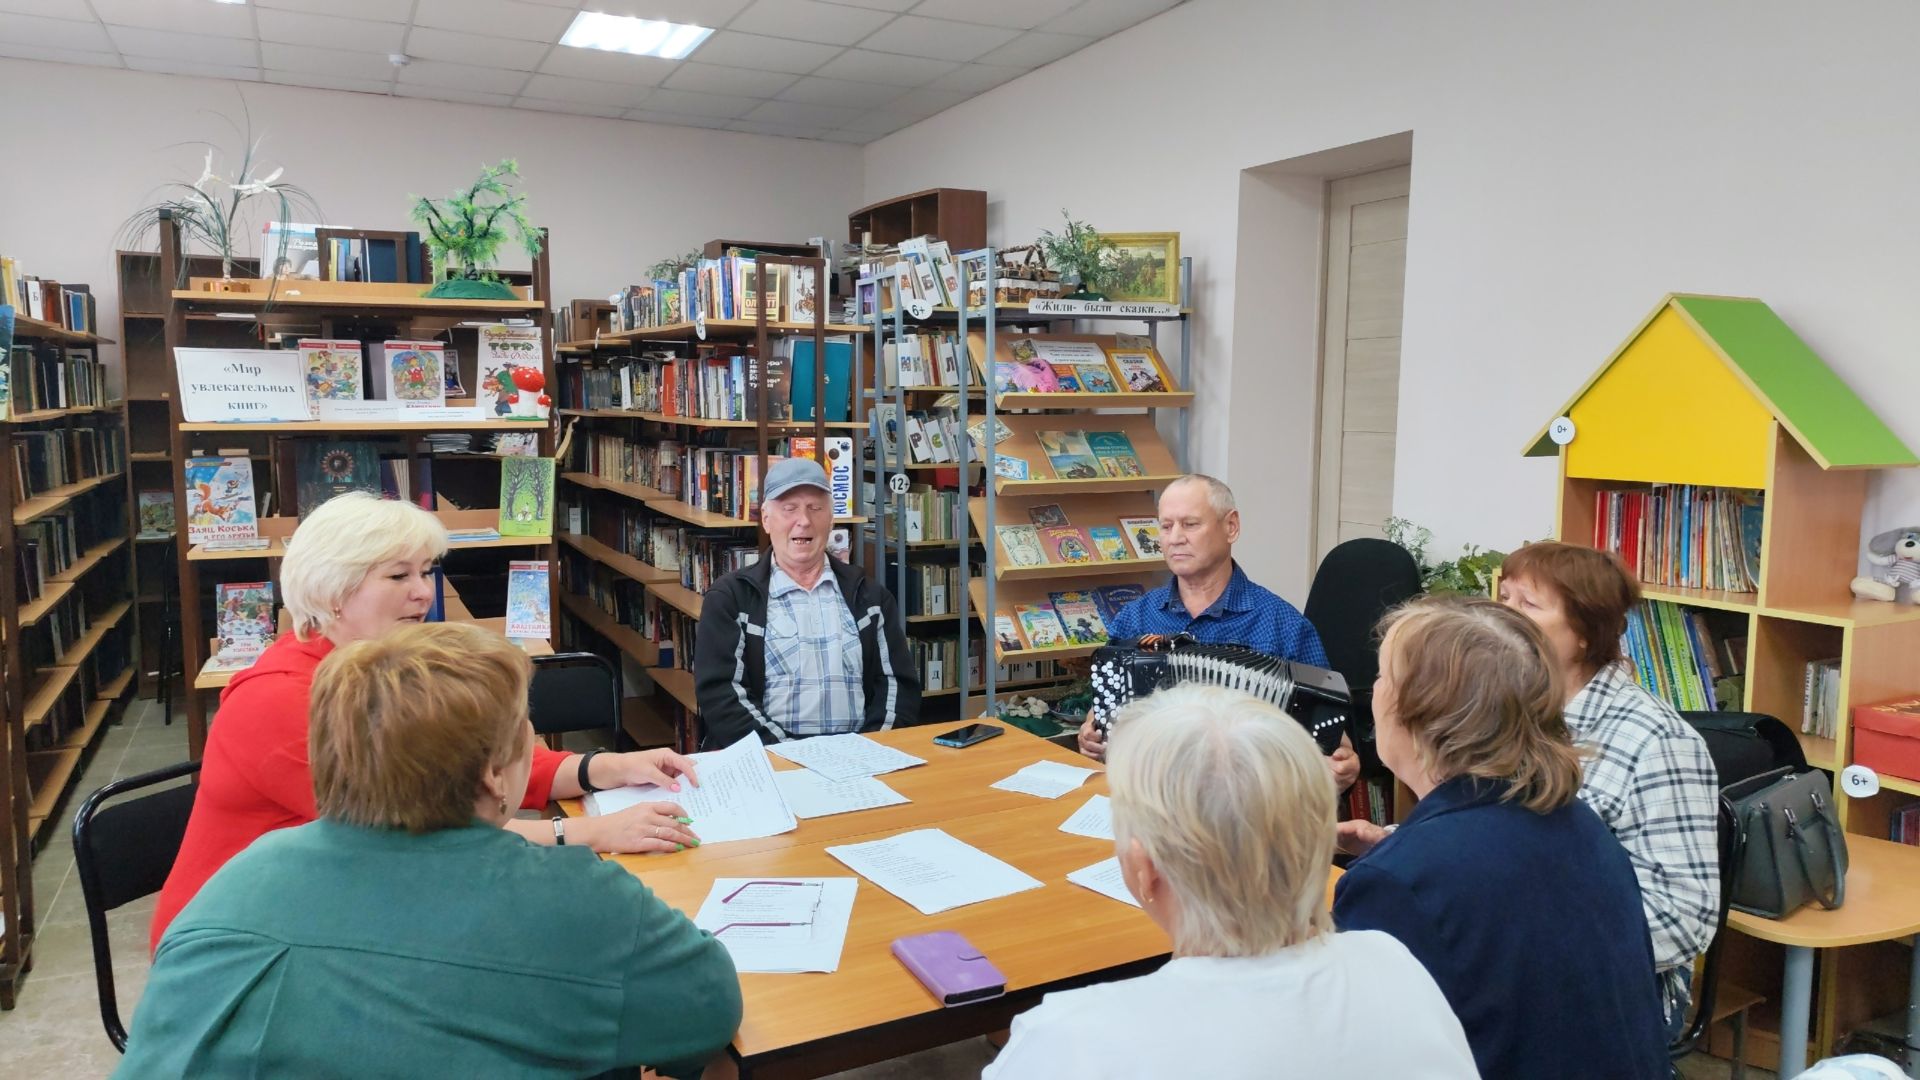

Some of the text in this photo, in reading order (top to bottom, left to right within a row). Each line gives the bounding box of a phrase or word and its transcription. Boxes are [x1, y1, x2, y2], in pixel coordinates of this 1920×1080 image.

[912, 304, 926, 316] 6+
[1084, 301, 1112, 312] были
[223, 363, 262, 376] «Мир
[191, 383, 296, 394] увлекательных
[228, 402, 268, 410] книг»
[1557, 425, 1567, 433] 0+
[890, 478, 910, 490] 12+
[833, 465, 850, 515] КОСМОС
[910, 521, 919, 530] А
[934, 595, 942, 603] Г
[931, 670, 940, 680] Д
[1851, 774, 1869, 786] 6+
